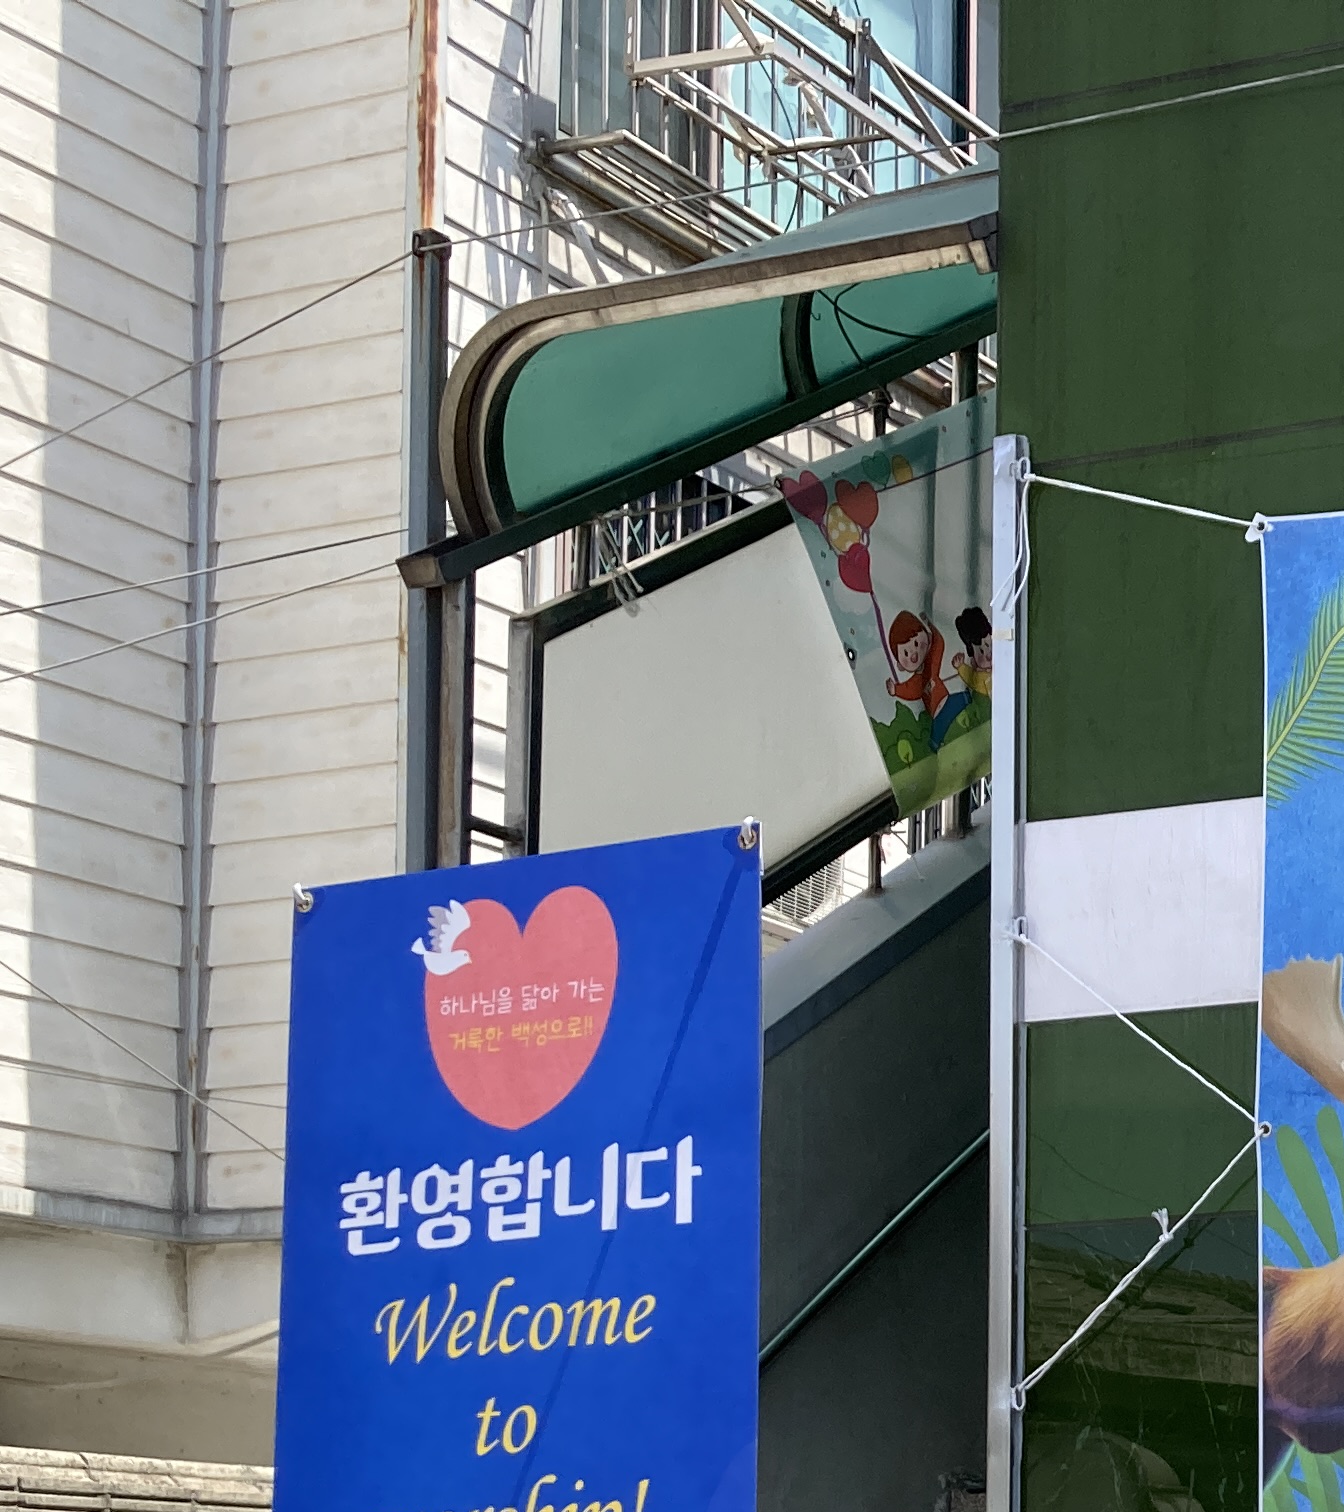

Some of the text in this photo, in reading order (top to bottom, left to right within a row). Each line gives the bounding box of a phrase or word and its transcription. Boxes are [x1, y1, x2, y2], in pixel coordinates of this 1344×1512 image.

[440, 977, 604, 1016] 하나님을 닮아 가는
[449, 1016, 593, 1053] 거룩한 백성으로!!
[338, 1135, 702, 1256] 환영합니다
[374, 1276, 657, 1365] Welcome
[475, 1396, 537, 1456] to
